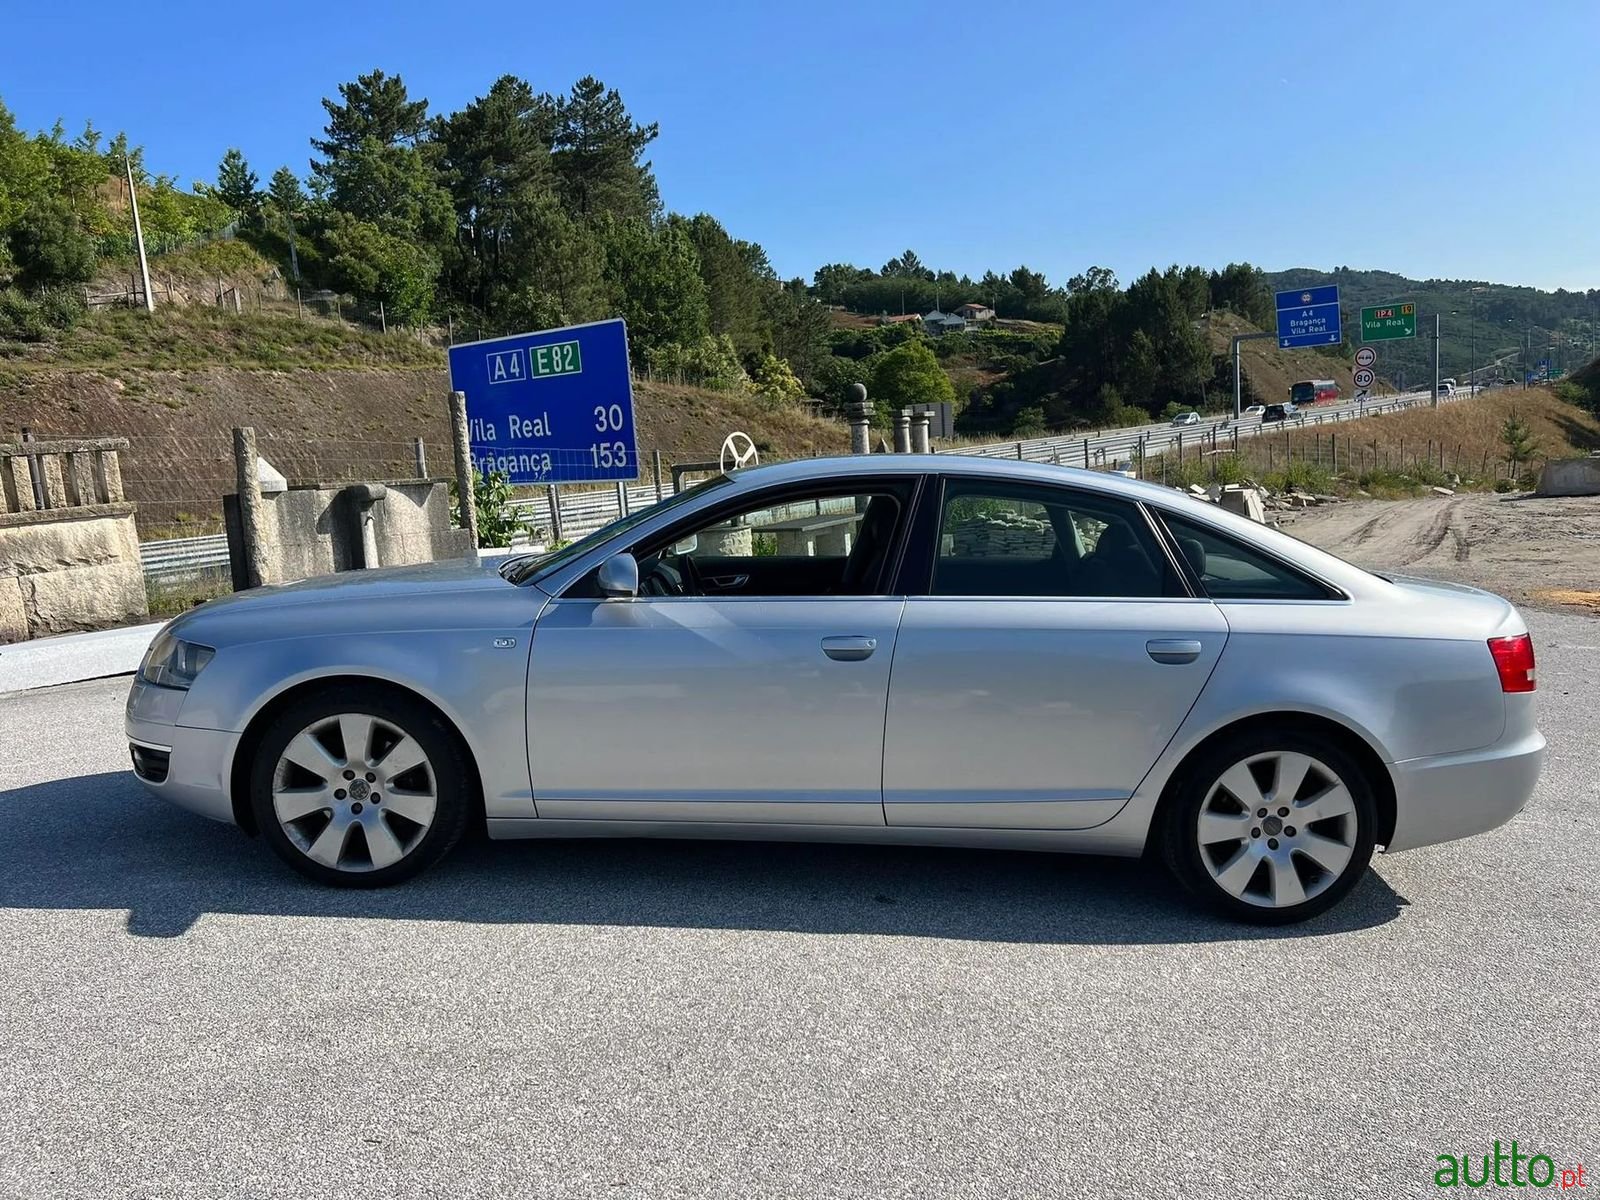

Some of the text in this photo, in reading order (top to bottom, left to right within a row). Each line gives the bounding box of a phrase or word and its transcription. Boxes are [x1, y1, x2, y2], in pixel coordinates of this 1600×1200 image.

[1290, 318, 1326, 327] Bragança
[1308, 325, 1326, 333] Real
[1365, 318, 1405, 329] Vila Real
[537, 344, 574, 374] E82
[1356, 374, 1371, 383] 80
[508, 411, 552, 439] Real
[594, 404, 623, 432] 30
[590, 441, 627, 469] 153
